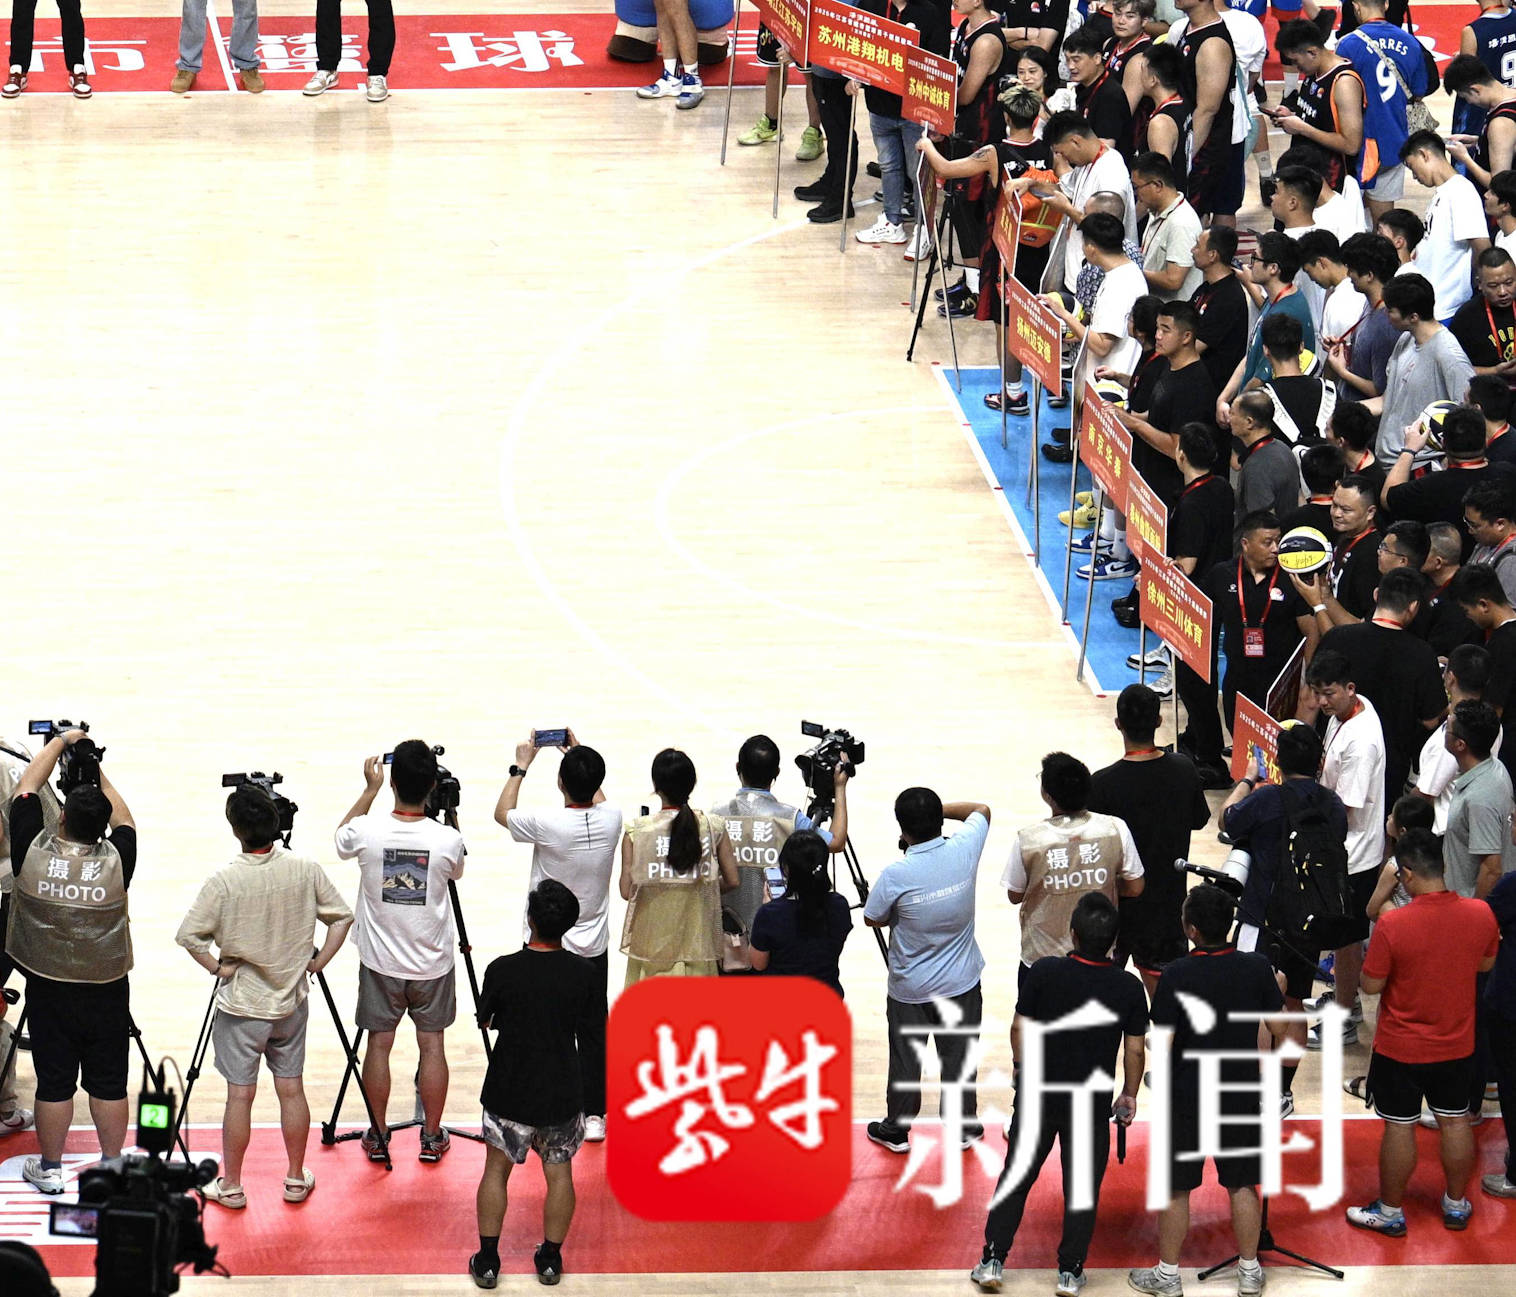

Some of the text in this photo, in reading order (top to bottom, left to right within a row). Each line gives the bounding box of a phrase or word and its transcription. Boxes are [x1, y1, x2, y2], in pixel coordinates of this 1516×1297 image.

[817, 24, 904, 73] 苏州港翔机电
[908, 76, 951, 112] 苏州中诚体育
[1375, 60, 1398, 104] 9
[1145, 579, 1204, 649] 徐州三川体育
[47, 857, 102, 882] 摄影
[1046, 843, 1101, 870] 摄影
[37, 881, 107, 903] PHOTO
[1043, 867, 1108, 890] PHOTO
